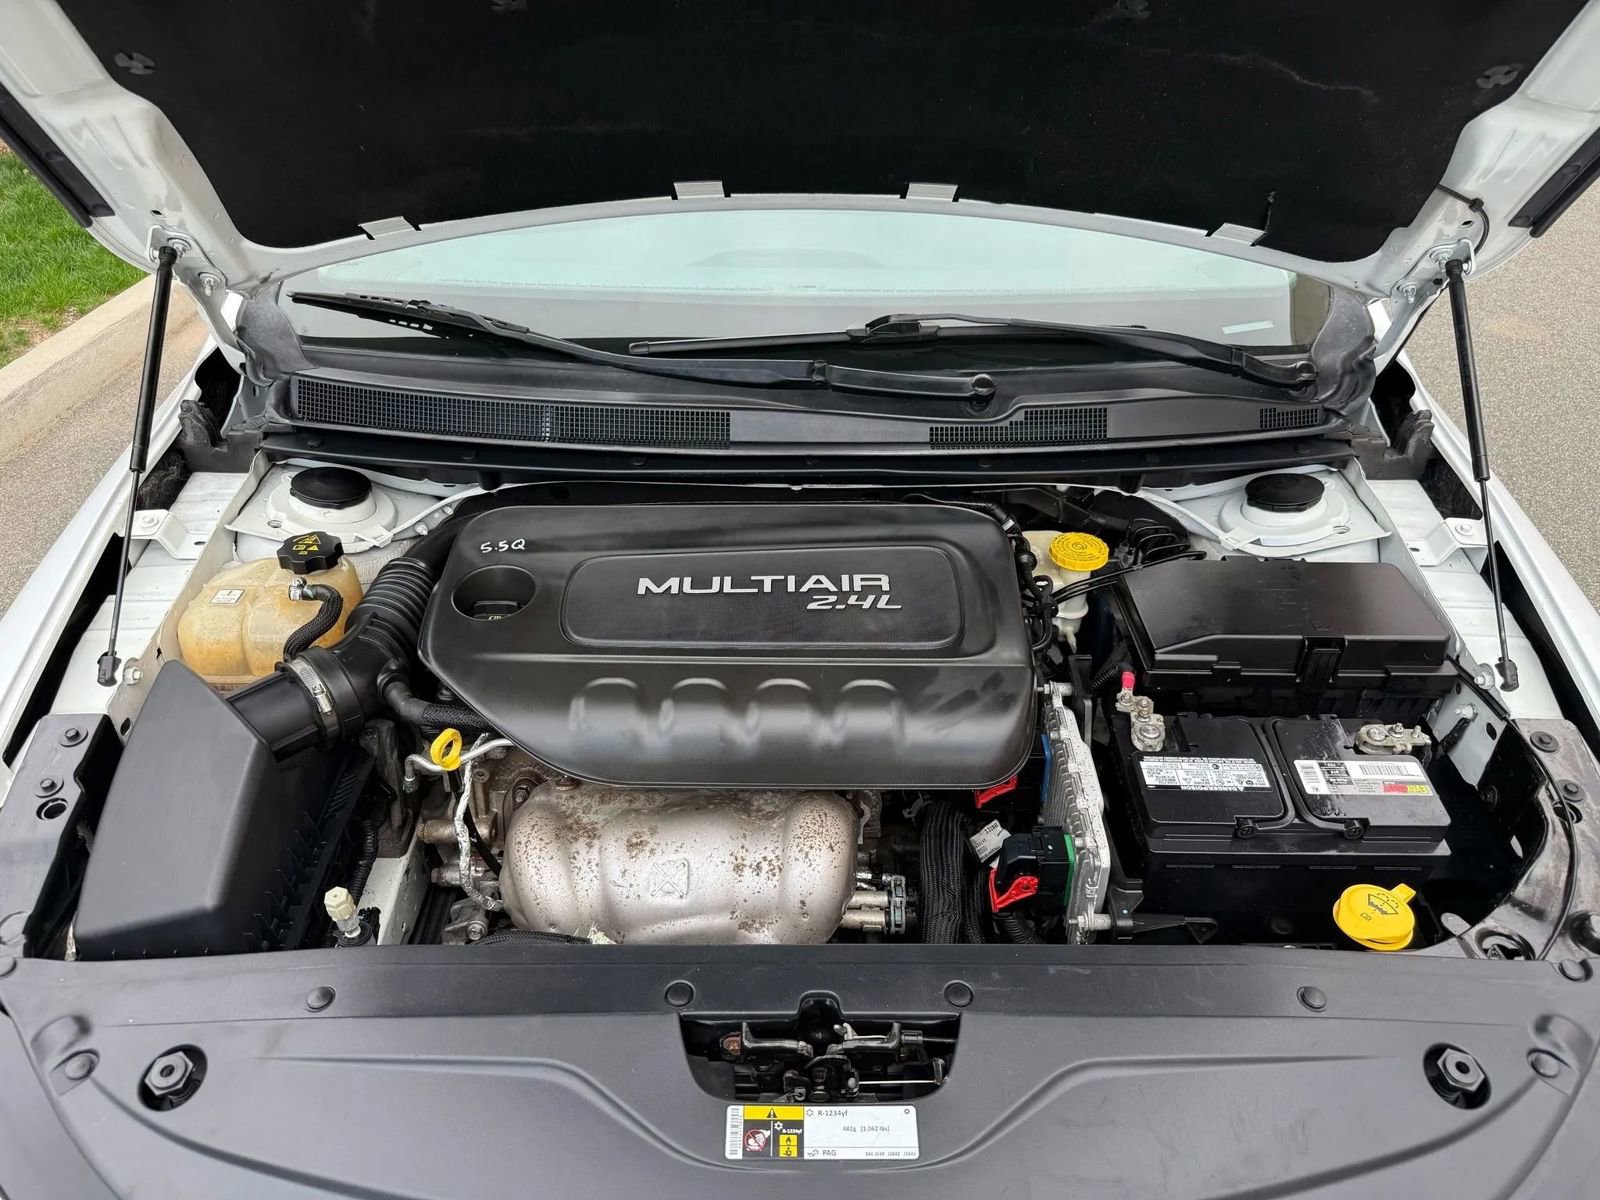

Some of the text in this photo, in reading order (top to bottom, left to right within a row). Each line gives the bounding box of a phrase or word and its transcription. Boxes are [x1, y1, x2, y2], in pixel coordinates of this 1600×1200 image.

[636, 573, 891, 595] MULTIAIR
[806, 595, 903, 610] 2.4L
[817, 1109, 848, 1117] R-1234yf
[822, 1149, 837, 1157] PAG
